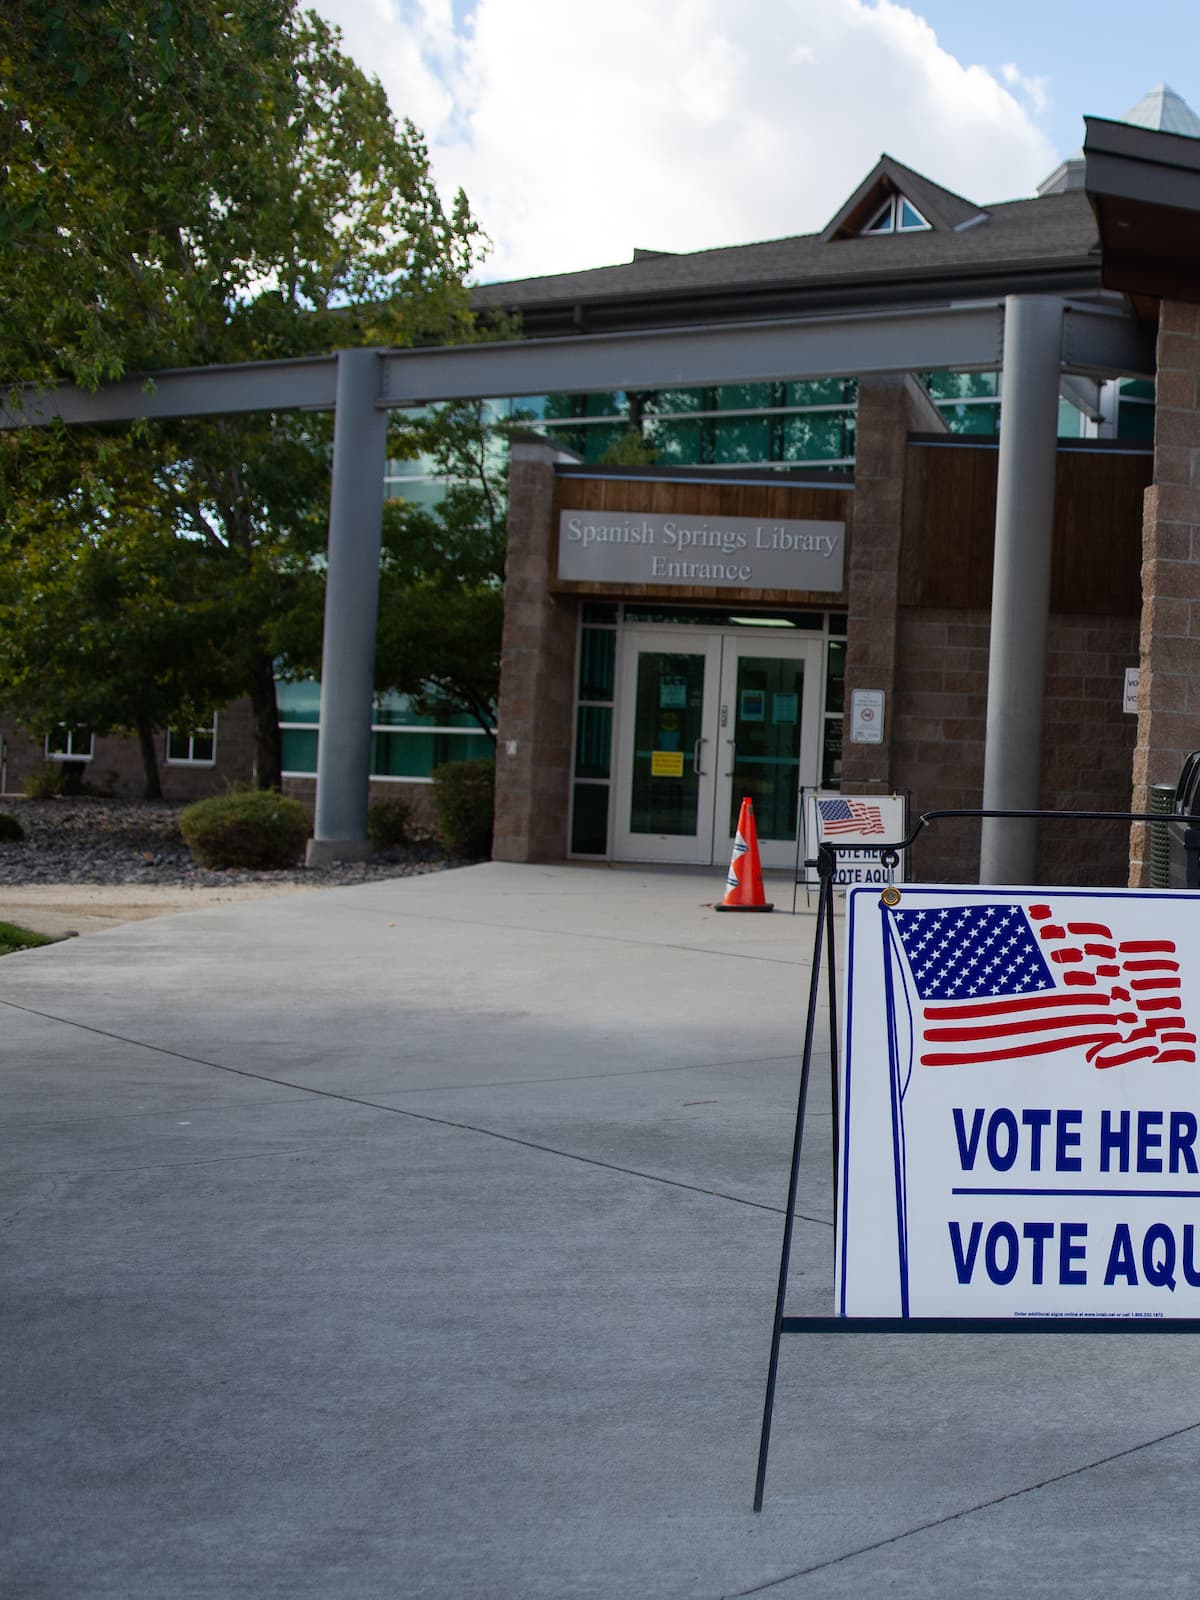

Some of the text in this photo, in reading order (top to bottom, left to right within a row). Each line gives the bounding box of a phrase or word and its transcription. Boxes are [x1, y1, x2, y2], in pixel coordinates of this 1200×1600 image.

[567, 518, 839, 558] Spanish Springs Library
[652, 556, 752, 581] Entrance
[952, 1108, 1082, 1173] VOTE
[948, 1221, 1088, 1285] VOTE
